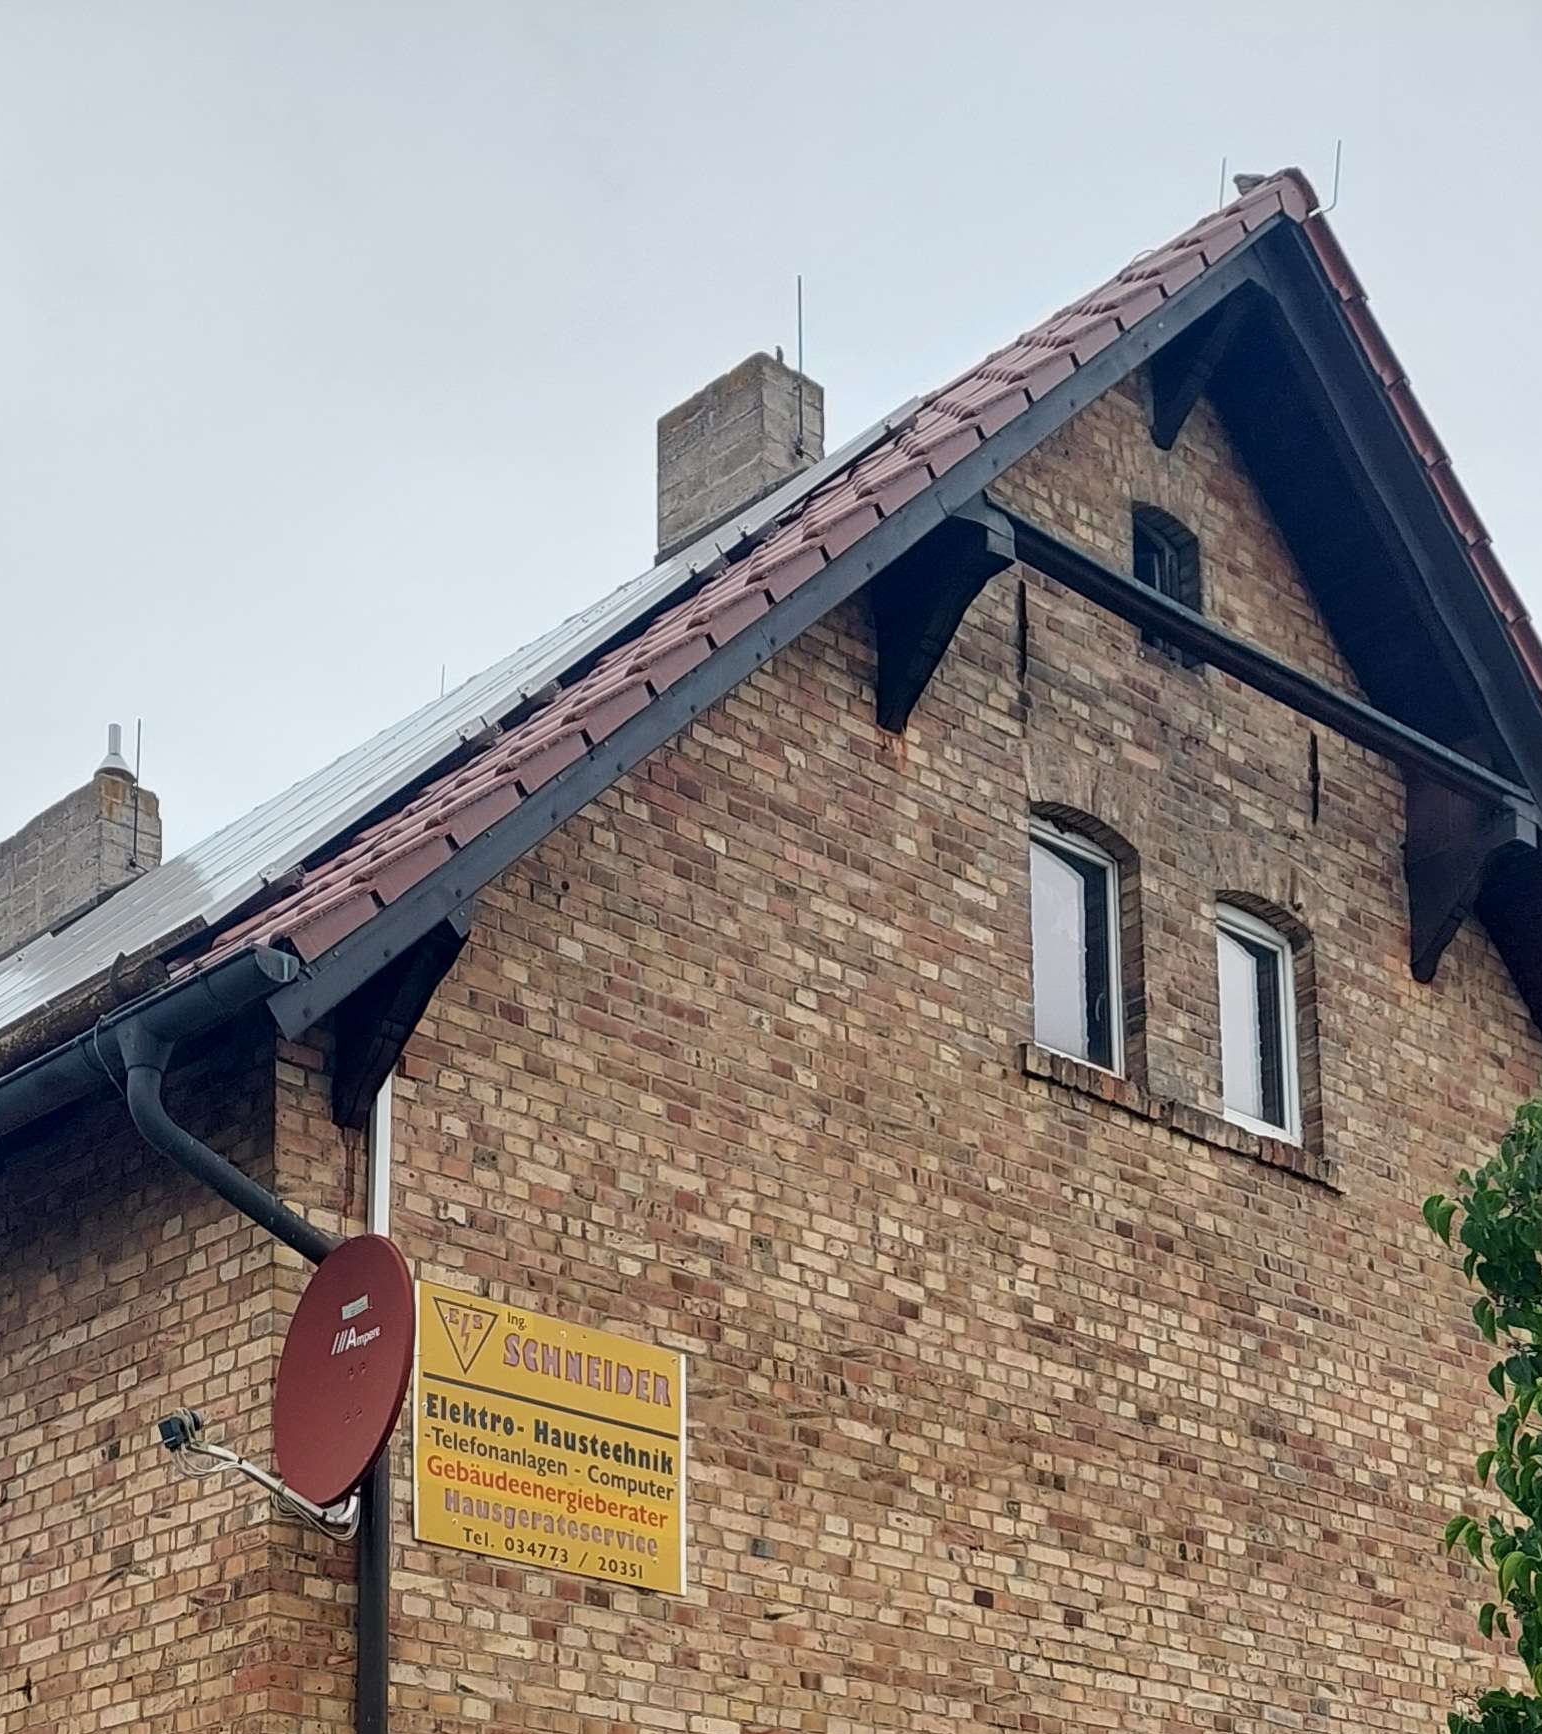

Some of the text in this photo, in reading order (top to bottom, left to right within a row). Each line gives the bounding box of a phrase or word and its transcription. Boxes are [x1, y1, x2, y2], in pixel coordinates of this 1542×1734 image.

[507, 1311, 528, 1331] Ing.
[503, 1332, 672, 1408] SCHNEIDER
[426, 1392, 674, 1476] Elektro- Haustechnik
[426, 1454, 669, 1529] Gebäudeenergieberater
[587, 1464, 675, 1501] Computer
[462, 1527, 495, 1549] Tel.
[504, 1536, 569, 1564] 034773
[597, 1556, 643, 1579] 20351
